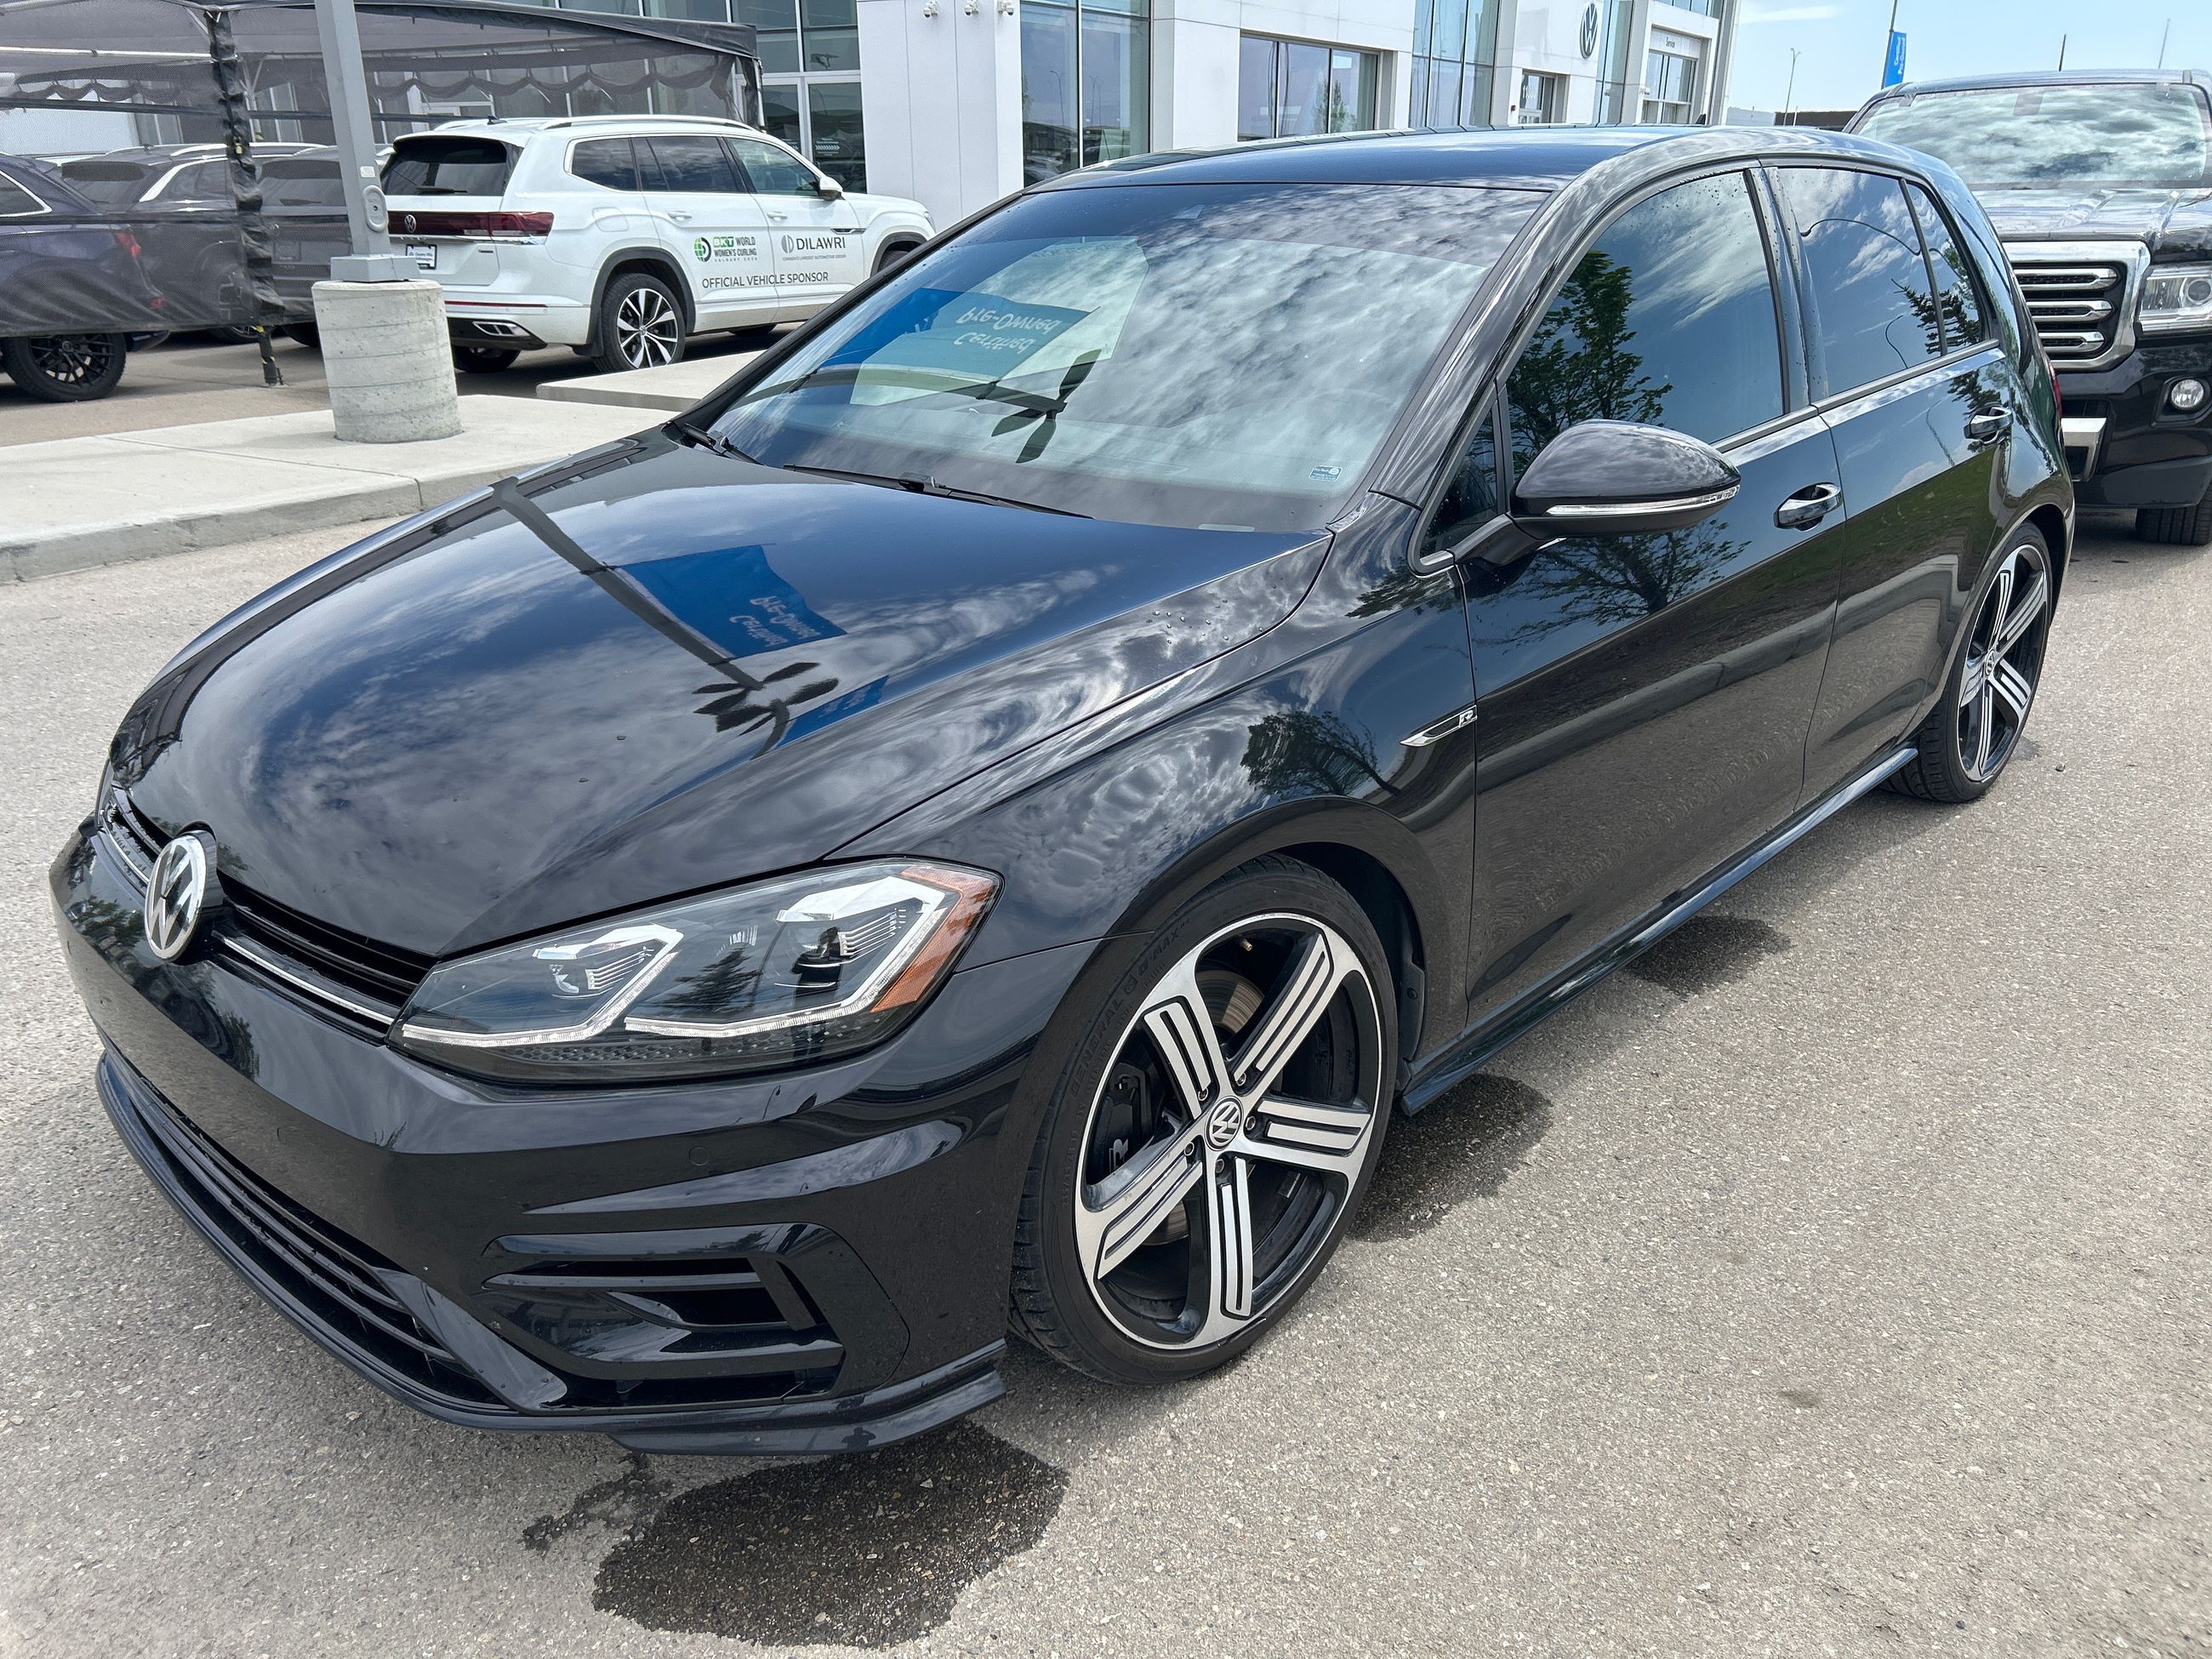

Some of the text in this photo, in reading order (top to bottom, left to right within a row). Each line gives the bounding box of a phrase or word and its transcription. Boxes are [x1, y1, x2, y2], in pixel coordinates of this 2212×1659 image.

[713, 237, 756, 247] BKT WORLD
[796, 237, 846, 250] DILAWRI
[714, 248, 757, 257] WOMEN'S CURLING
[702, 271, 829, 289] OFFICIAL VEHICLE SPONSOR
[1069, 995, 1124, 1097] GENERAL
